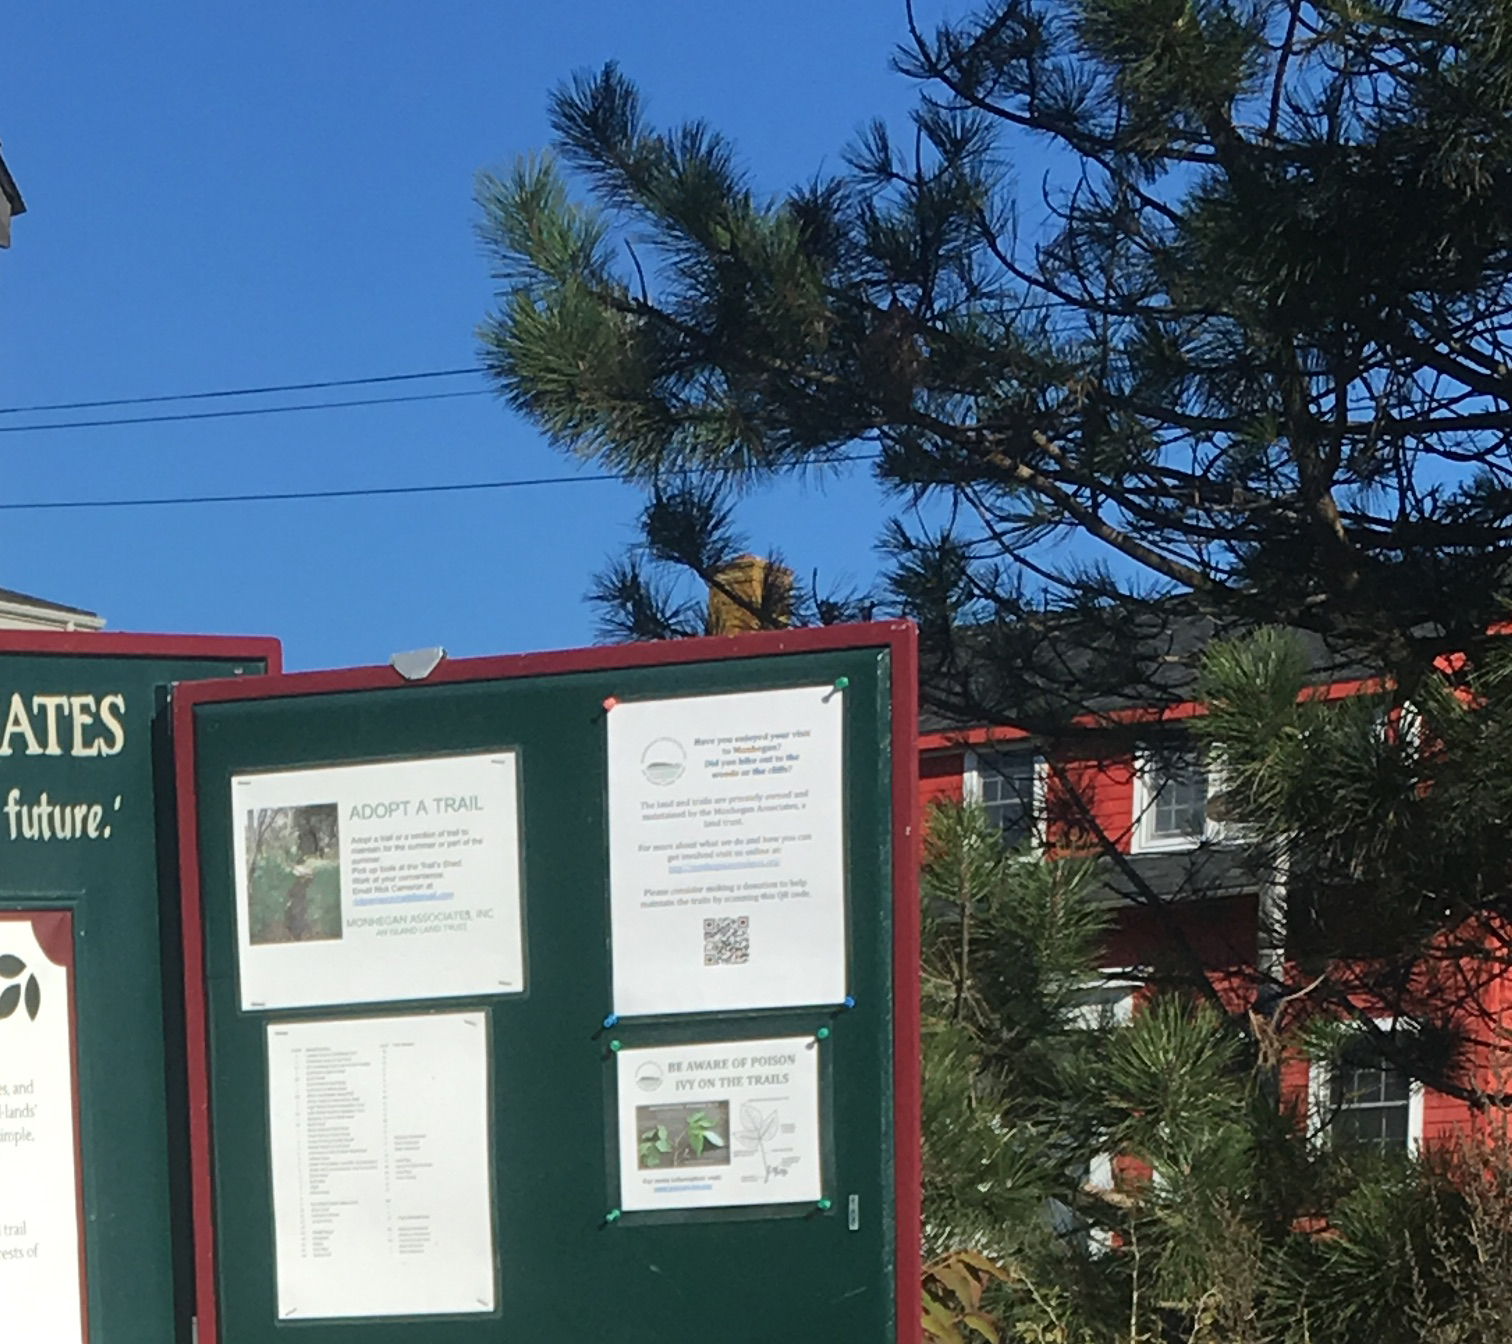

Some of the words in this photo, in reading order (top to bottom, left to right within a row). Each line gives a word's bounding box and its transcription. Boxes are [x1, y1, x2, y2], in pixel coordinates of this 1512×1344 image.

[348, 799, 410, 821] ADOPT
[415, 799, 428, 815] A
[432, 794, 483, 814] TRAIL
[345, 914, 407, 928] MONHEGAN
[475, 908, 493, 918] INC
[667, 1060, 683, 1073] BE
[685, 1058, 728, 1071] AWARE
[731, 1056, 747, 1068] OF
[750, 1053, 795, 1068] POISON
[12, 1078, 34, 1095] and
[675, 1078, 695, 1091] IVY
[697, 1077, 715, 1089] ON
[718, 1075, 743, 1088] THE
[745, 1073, 789, 1085] TRAILS
[3, 1219, 26, 1236] trail
[26, 1243, 38, 1258] of
